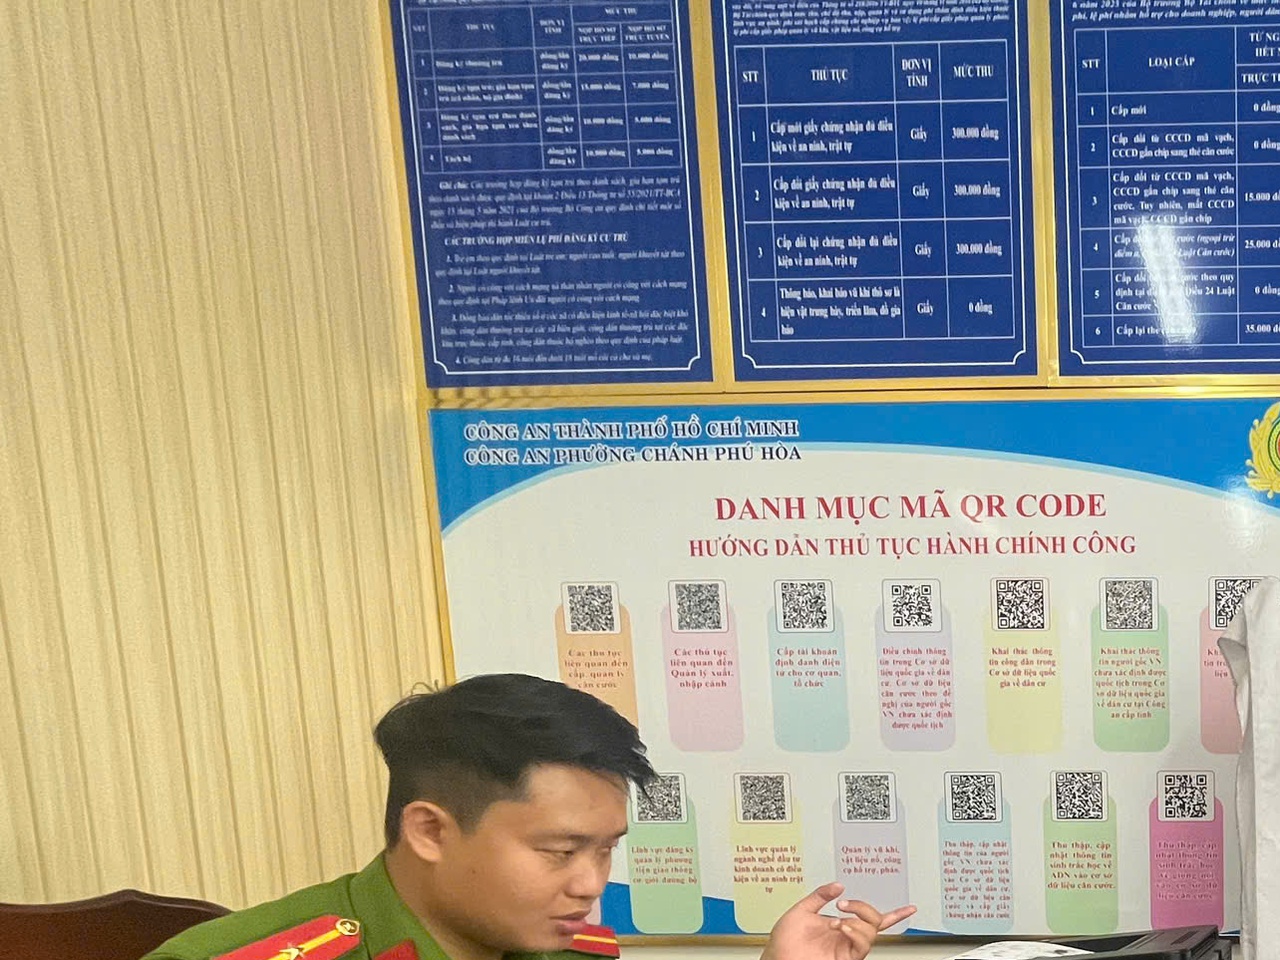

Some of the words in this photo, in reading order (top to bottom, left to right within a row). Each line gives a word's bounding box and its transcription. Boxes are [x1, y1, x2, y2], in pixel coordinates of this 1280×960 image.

[953, 64, 975, 78] MỨC
[975, 65, 994, 77] THU
[1082, 58, 1100, 69] STT
[742, 70, 759, 83] STT
[810, 68, 828, 81] THỦ
[831, 68, 848, 85] TỤC
[464, 420, 519, 441] CÔNG
[522, 423, 551, 440] AN
[554, 418, 623, 439] THÀNH
[627, 415, 667, 439] PHỐ
[672, 414, 701, 439] HỒ
[706, 417, 742, 438] CHÍ
[745, 419, 799, 437] MINH
[464, 445, 519, 465] CÔNG
[522, 448, 551, 465] AN
[554, 443, 636, 464] PHƯỜNG
[641, 441, 709, 463] CHÁNH
[714, 441, 754, 462] PHÚ
[760, 441, 802, 461] HÒA
[715, 496, 806, 521] DANH
[816, 495, 890, 526] MỤC
[899, 489, 952, 519] MÃ
[960, 493, 1008, 524] QR
[1016, 493, 1107, 518] CODE
[689, 533, 769, 558] HƯỚNG
[825, 532, 870, 557] THỦ
[876, 537, 921, 560] TỤC
[926, 531, 988, 556] HÀNH
[995, 530, 1066, 555] CHÍNH
[1072, 530, 1137, 555] CÔNG
